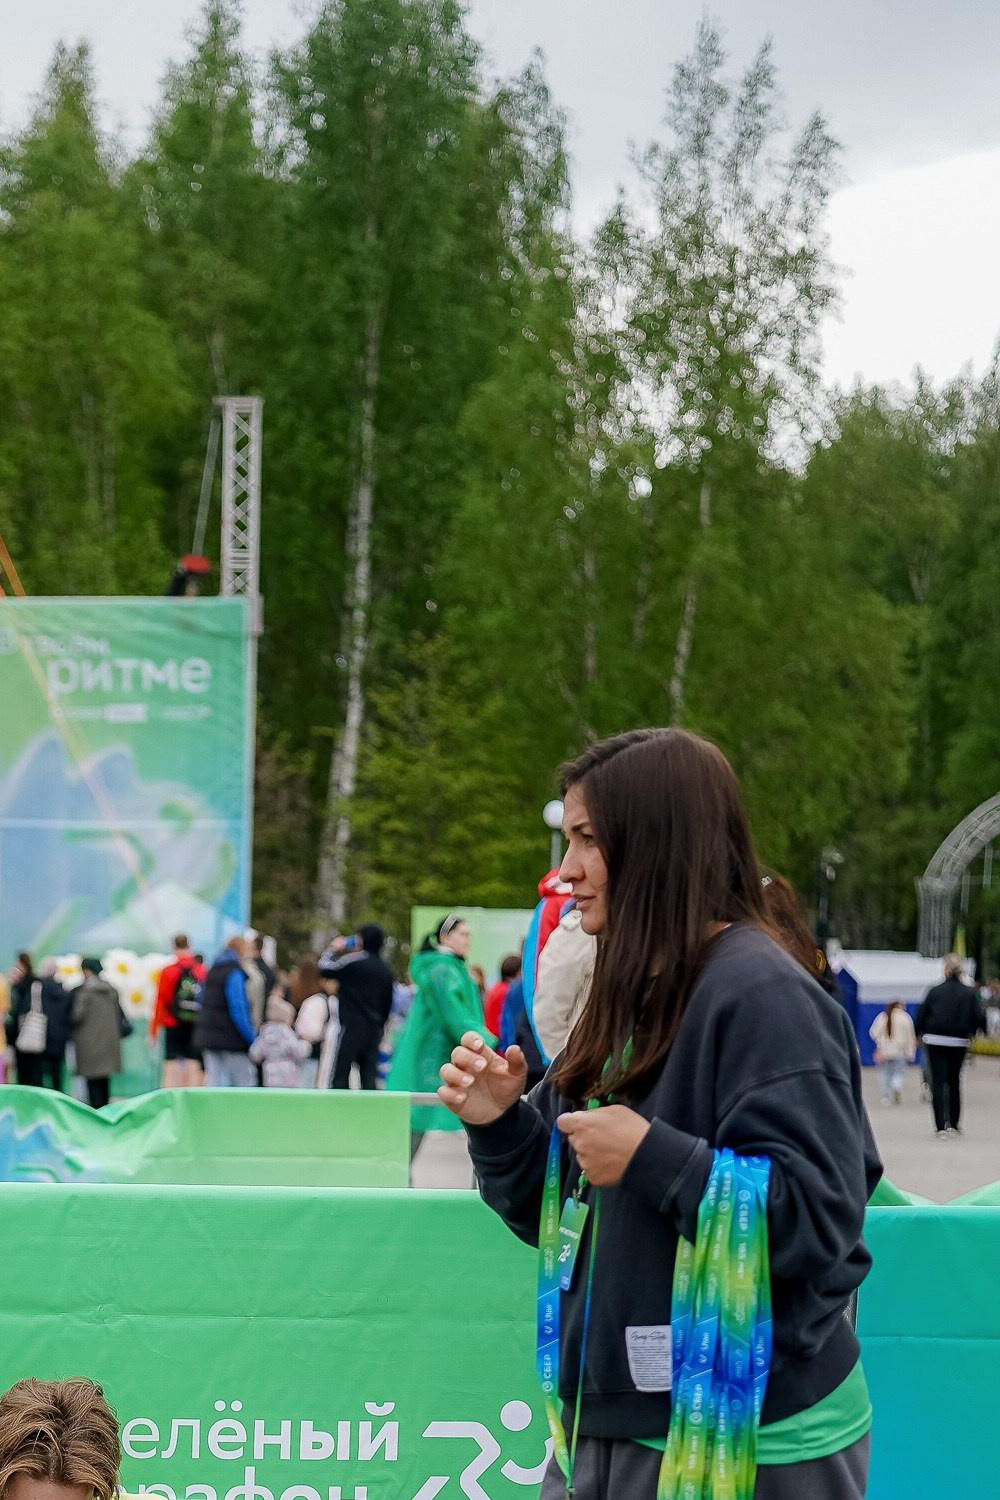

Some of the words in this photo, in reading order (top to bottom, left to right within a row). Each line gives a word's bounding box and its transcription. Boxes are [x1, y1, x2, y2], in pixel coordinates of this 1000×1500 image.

[48, 658, 212, 704] ритме
[543, 1353, 552, 1379] СБЕР
[121, 1400, 398, 1461] елёный
